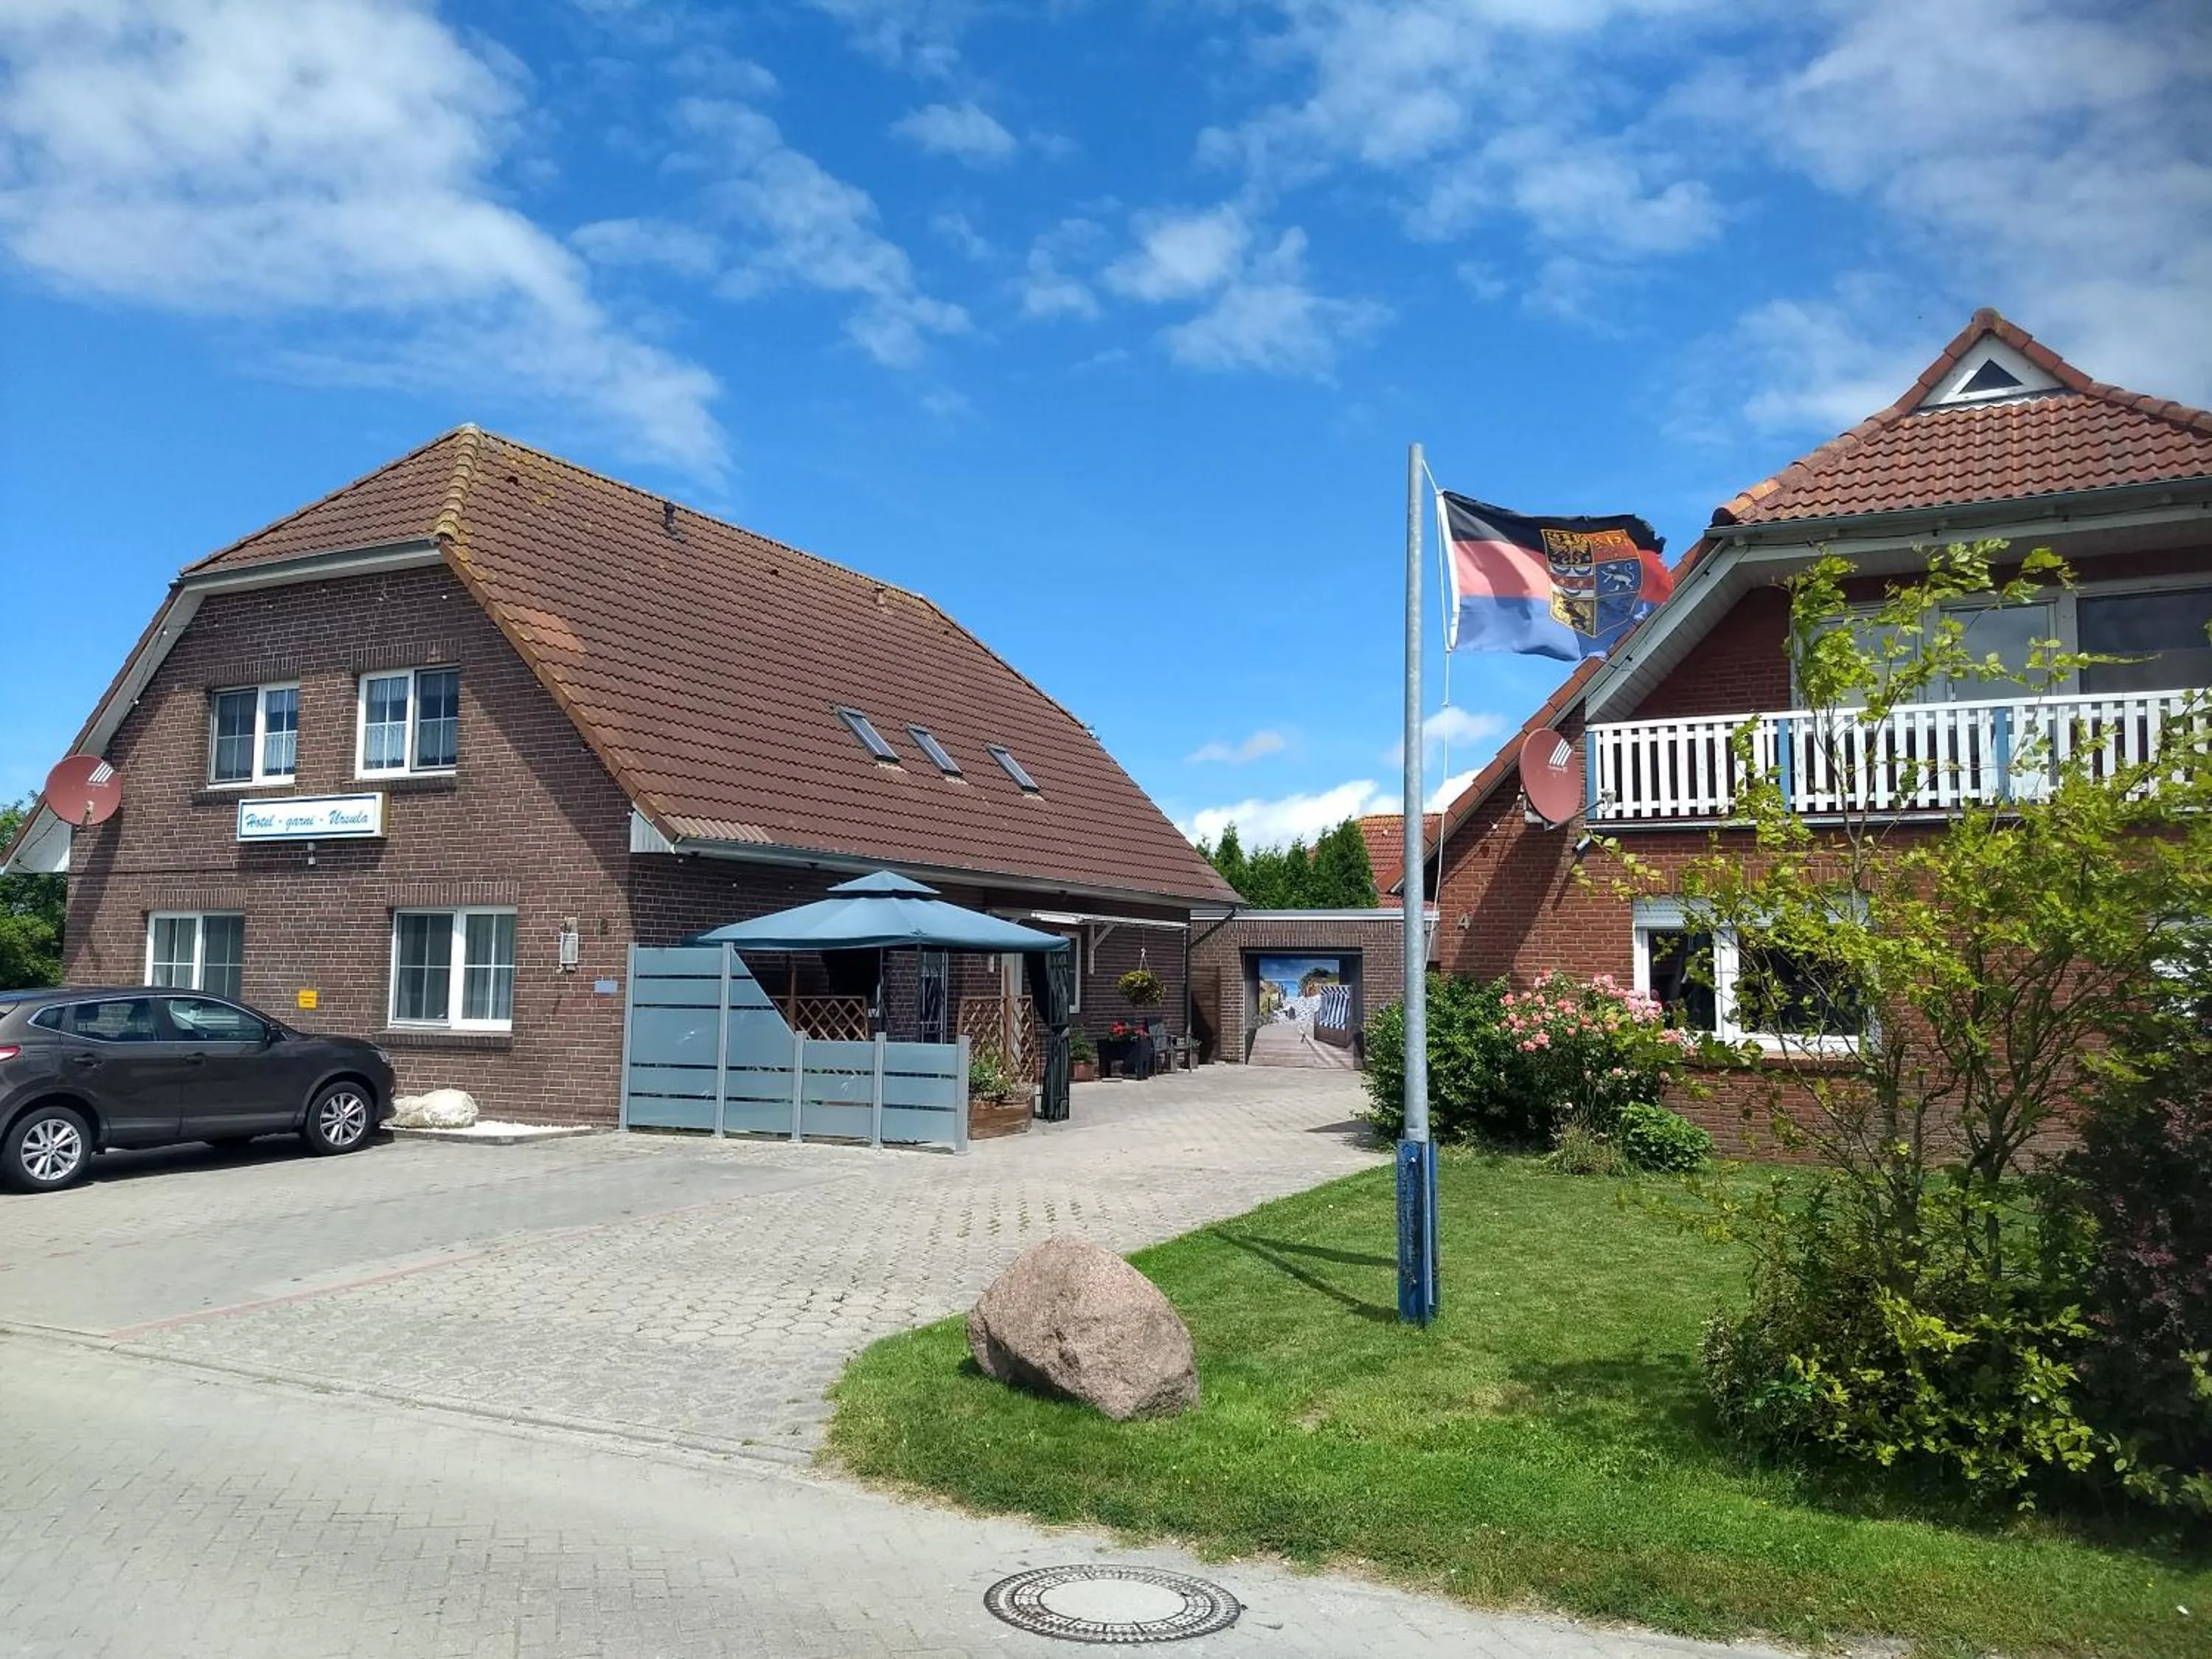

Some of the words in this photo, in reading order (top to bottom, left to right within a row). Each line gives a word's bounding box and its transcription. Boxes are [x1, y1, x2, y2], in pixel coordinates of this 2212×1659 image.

[246, 813, 275, 827] Hotel
[285, 815, 314, 832] garni
[328, 809, 368, 825] Ursula
[1458, 912, 1471, 930] 4
